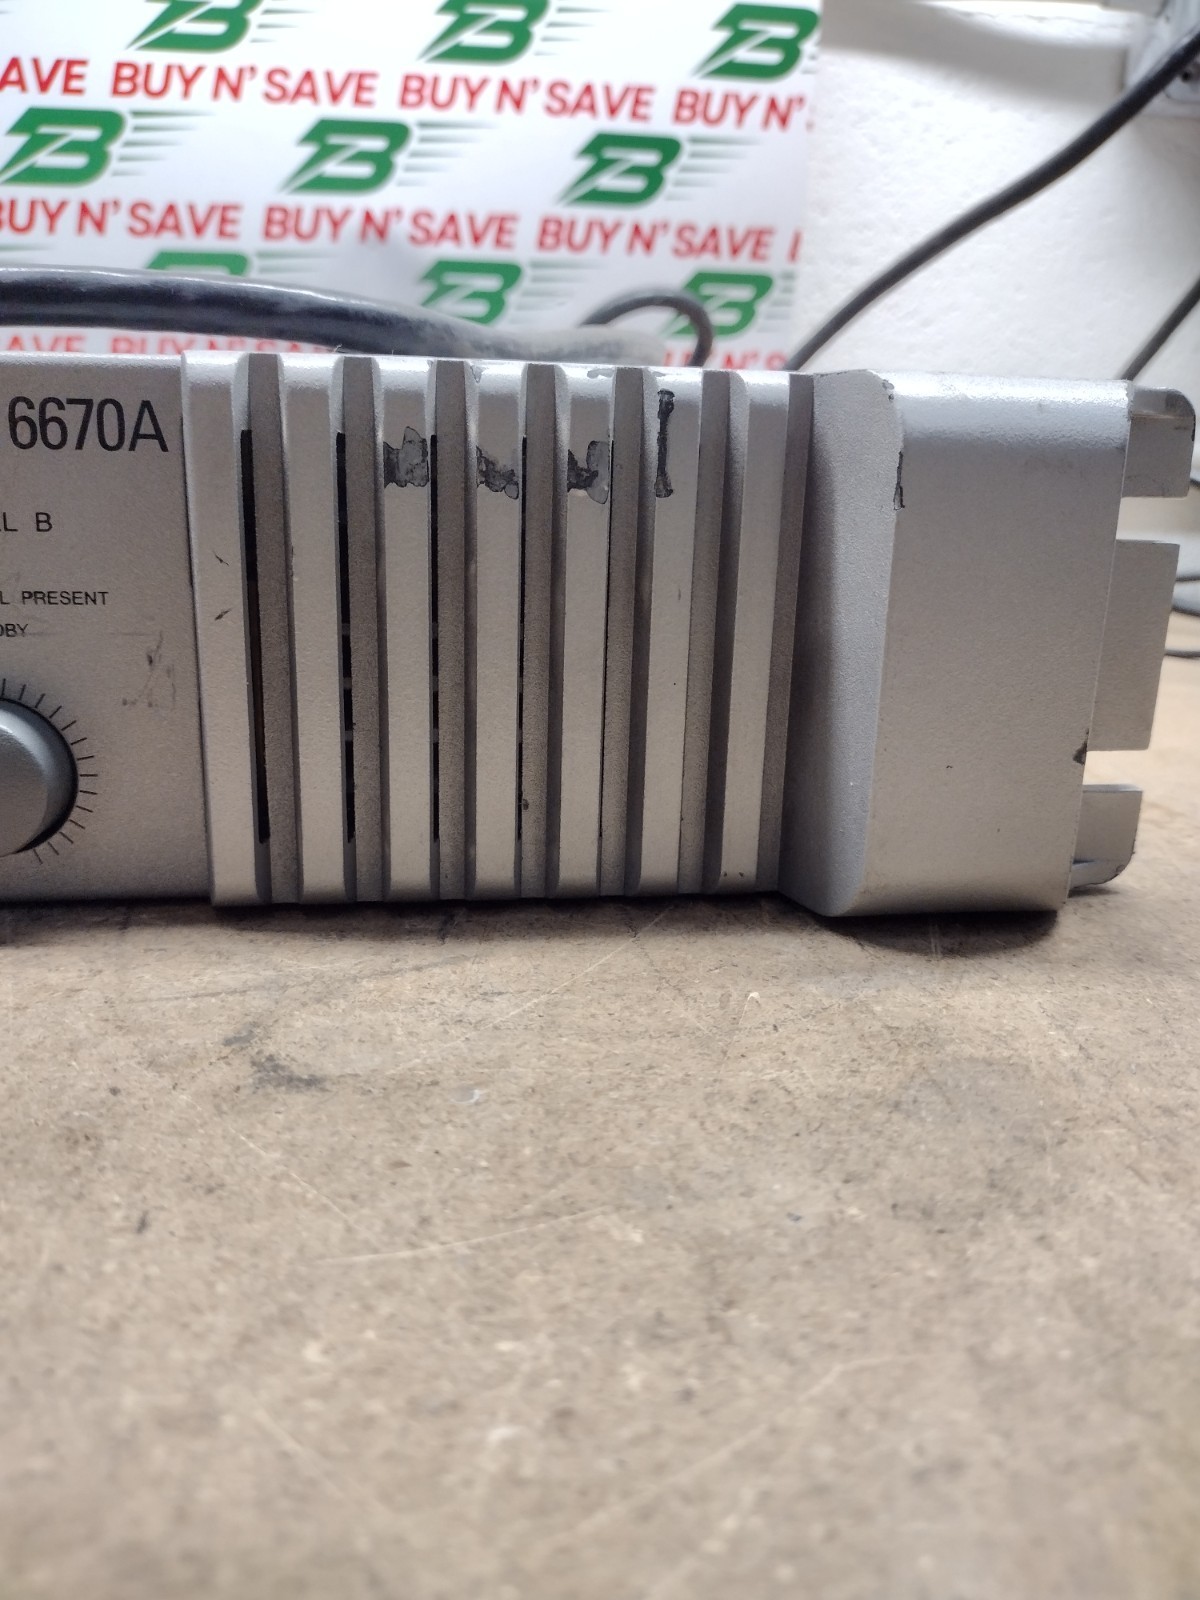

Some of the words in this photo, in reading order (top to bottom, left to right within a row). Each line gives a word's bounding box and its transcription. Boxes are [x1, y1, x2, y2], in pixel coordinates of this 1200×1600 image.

[111, 61, 205, 99] BUY
[263, 68, 378, 107] SAVE
[399, 72, 490, 111] BUY
[544, 79, 654, 121] SAVE
[672, 88, 759, 127] BUY
[127, 201, 240, 240] SAVE
[263, 204, 351, 242] BUY
[409, 210, 518, 250] SAVE
[536, 216, 621, 253] BUY
[673, 223, 774, 262] SAVE
[8, 396, 169, 452] 6670A
[36, 512, 53, 532] B
[21, 591, 109, 606] PRESENT
